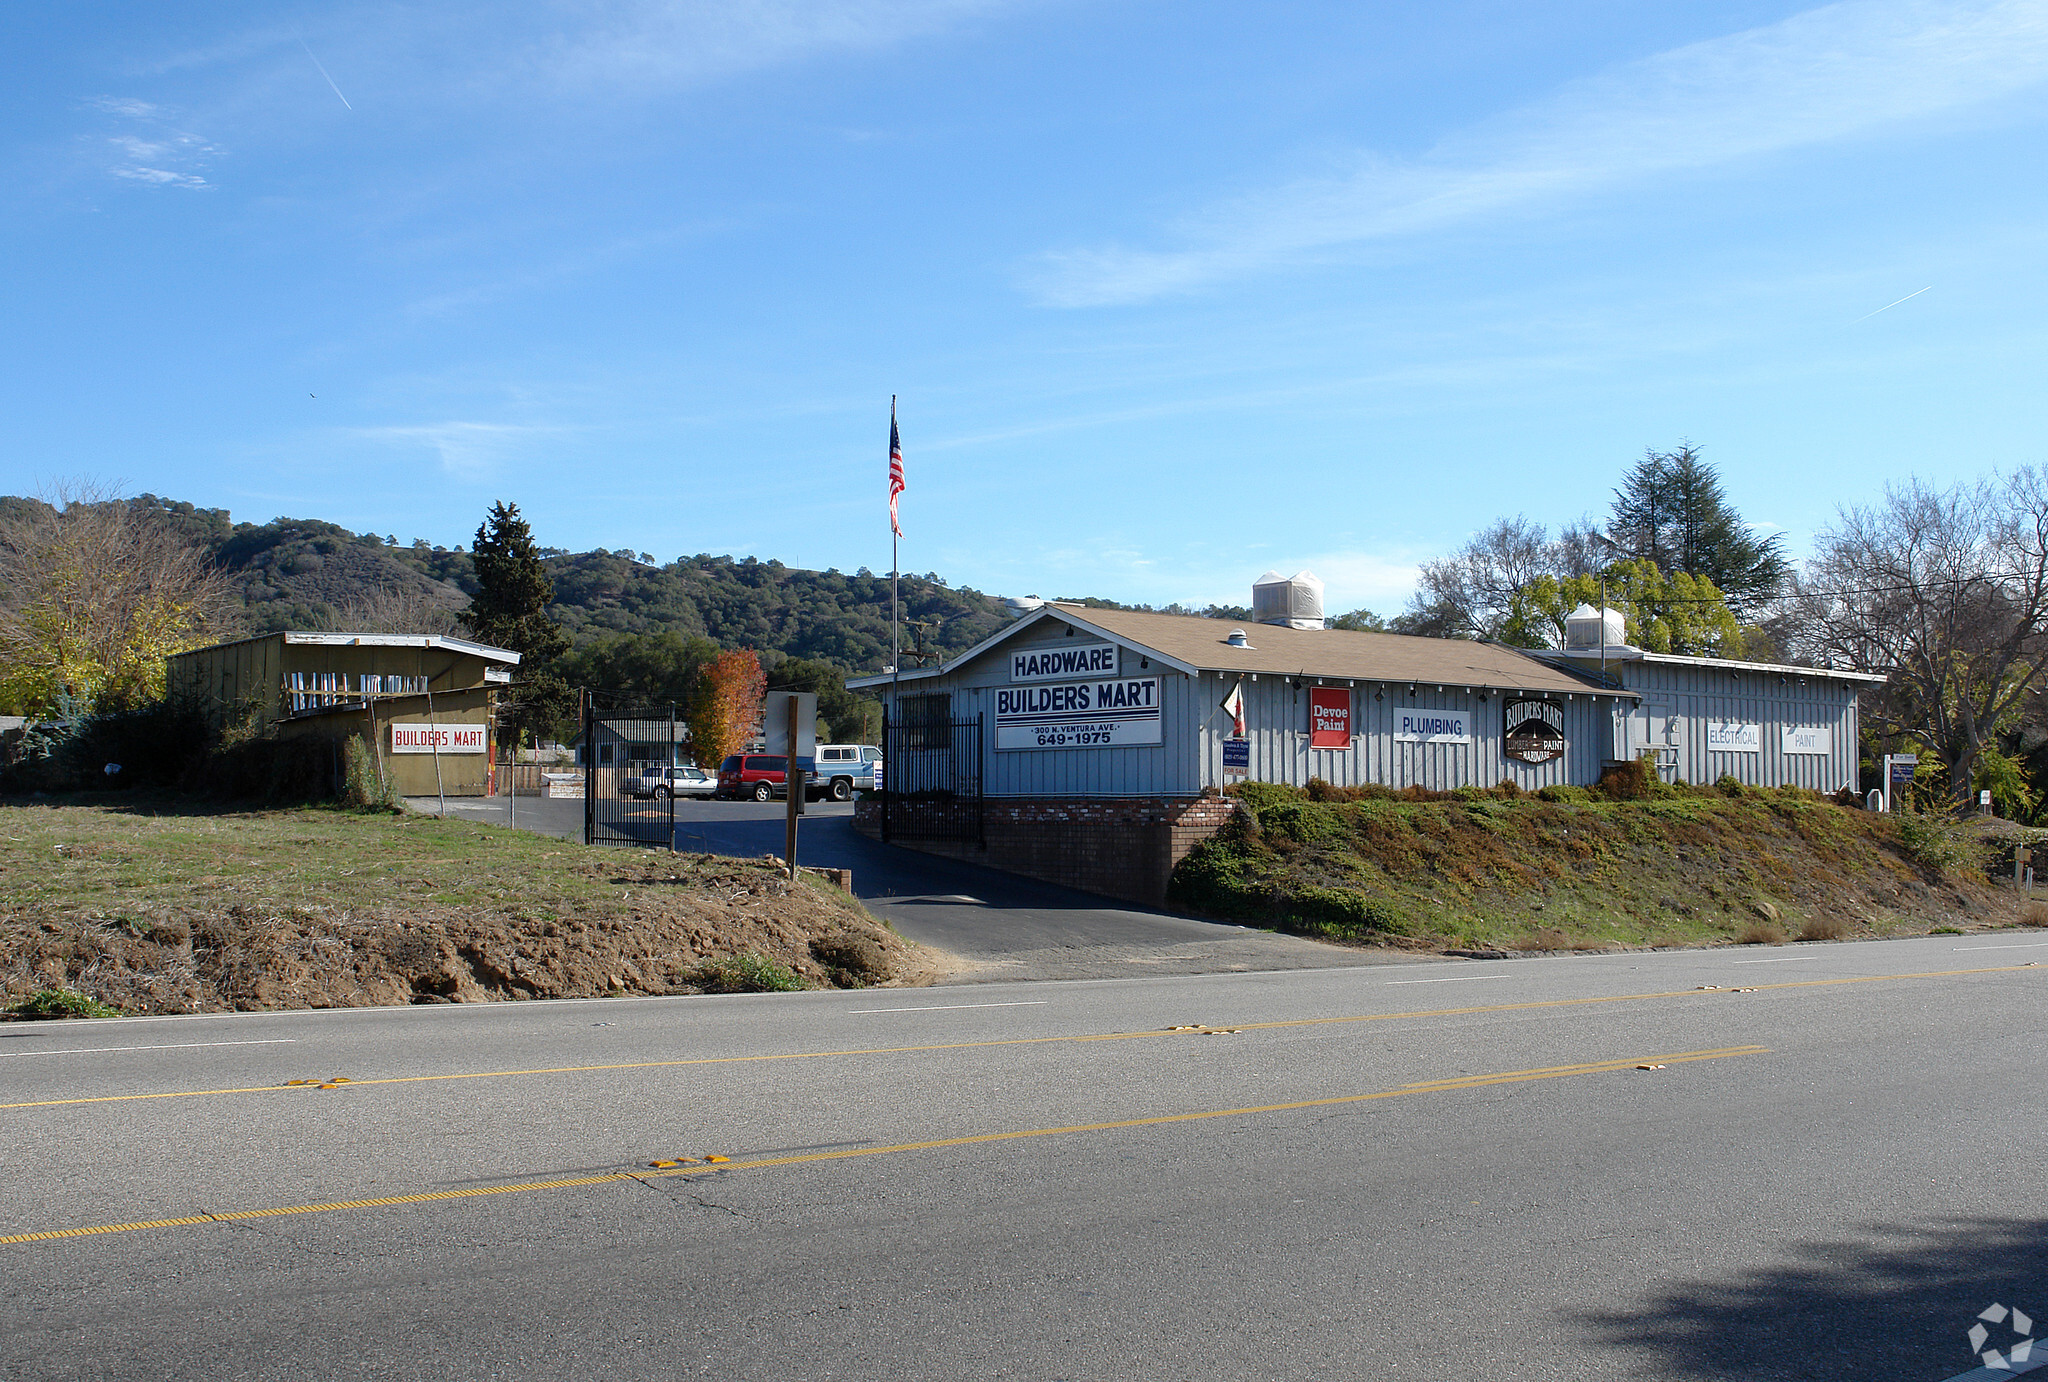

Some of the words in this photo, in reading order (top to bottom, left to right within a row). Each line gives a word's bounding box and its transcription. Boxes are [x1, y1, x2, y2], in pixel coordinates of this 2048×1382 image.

[1015, 648, 1114, 677] HARDWARE
[998, 684, 1090, 714] BUILDERS
[1097, 681, 1155, 708] MART
[1313, 705, 1348, 718] Devoe
[1506, 701, 1542, 731] BUILDERS
[1543, 702, 1563, 732] MART
[1316, 718, 1345, 731] Paint
[1402, 716, 1462, 735] PLUMBING
[395, 730, 448, 746] BUILDERS
[454, 731, 482, 746] MART
[1037, 732, 1111, 746] 649-1975
[1709, 729, 1758, 745] ELECTRICAL
[1795, 734, 1816, 748] PAINT
[1507, 740, 1530, 750] LUMBER
[1543, 740, 1563, 750] PAINT
[1522, 750, 1550, 763] HARDWARE
[1224, 767, 1234, 775] FOR
[1235, 767, 1248, 775] SALE
